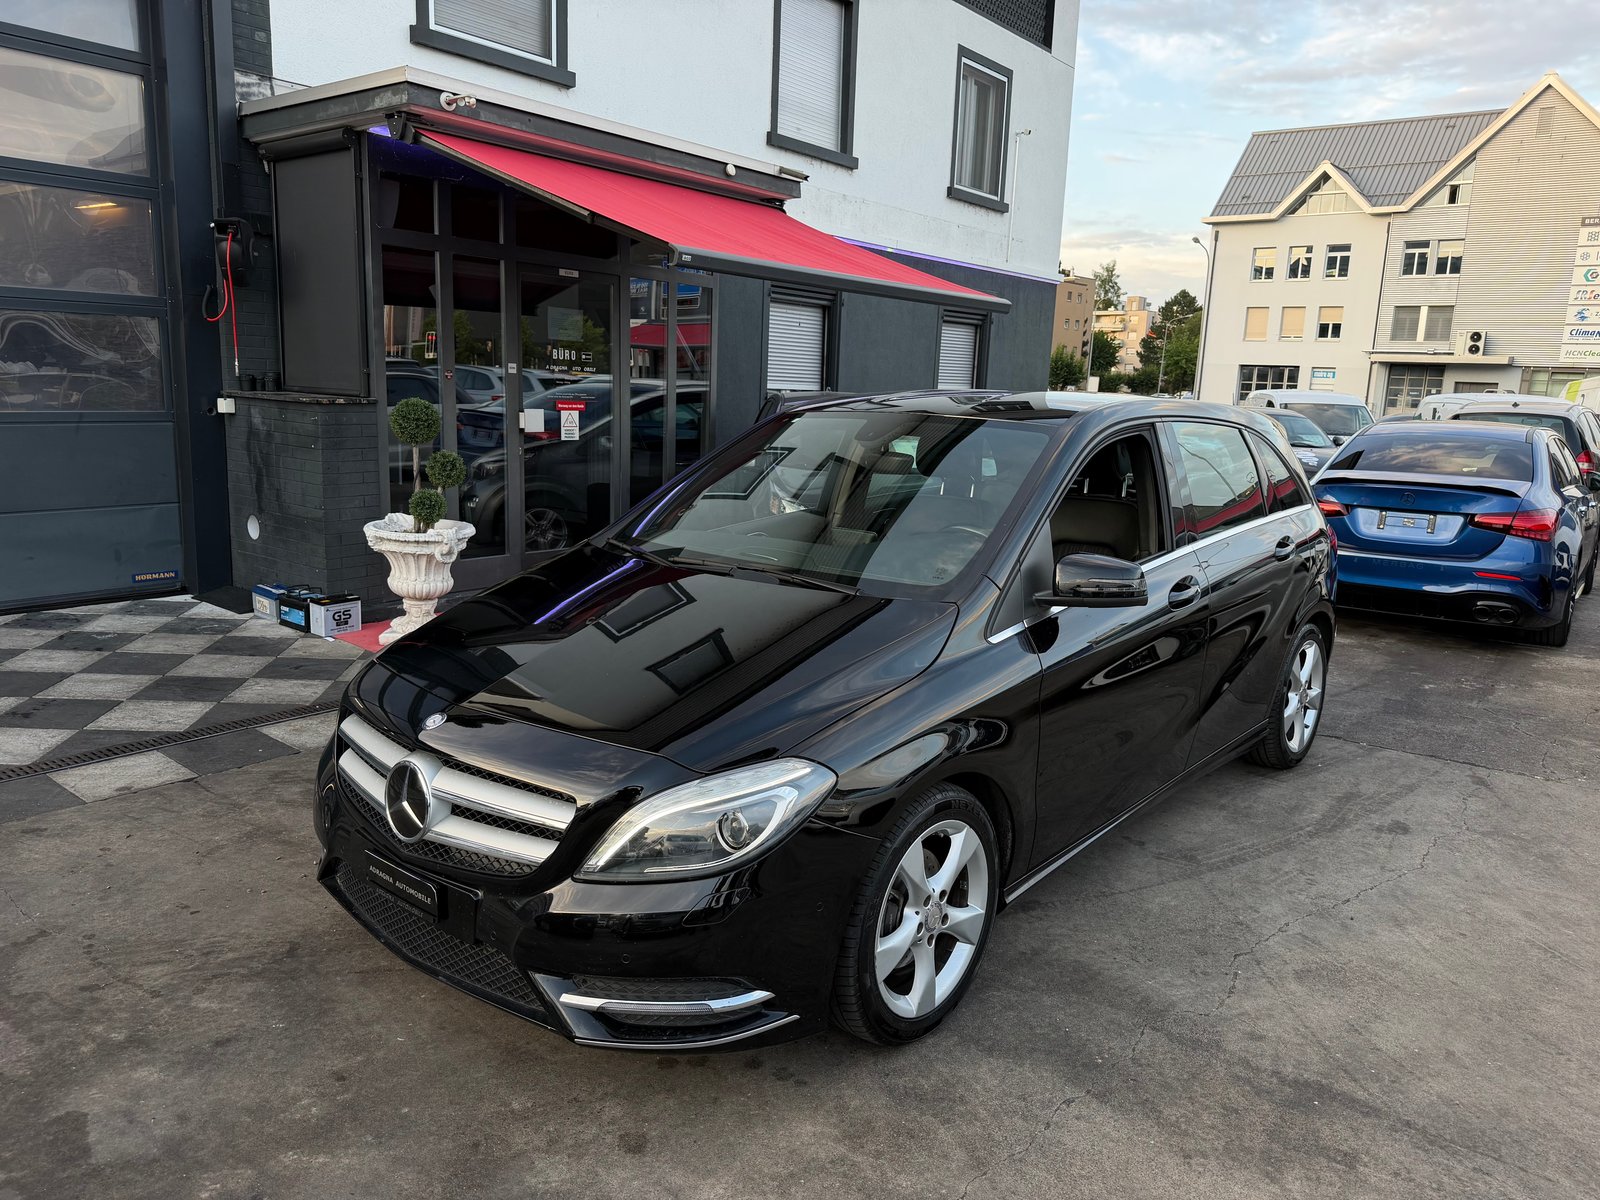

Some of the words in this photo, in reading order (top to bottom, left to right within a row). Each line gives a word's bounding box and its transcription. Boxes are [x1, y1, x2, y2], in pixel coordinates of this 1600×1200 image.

[552, 347, 576, 360] BÜRO
[332, 609, 352, 621] GS
[369, 865, 393, 884] ADRAGNA
[395, 880, 432, 905] AUTOMOBILE
